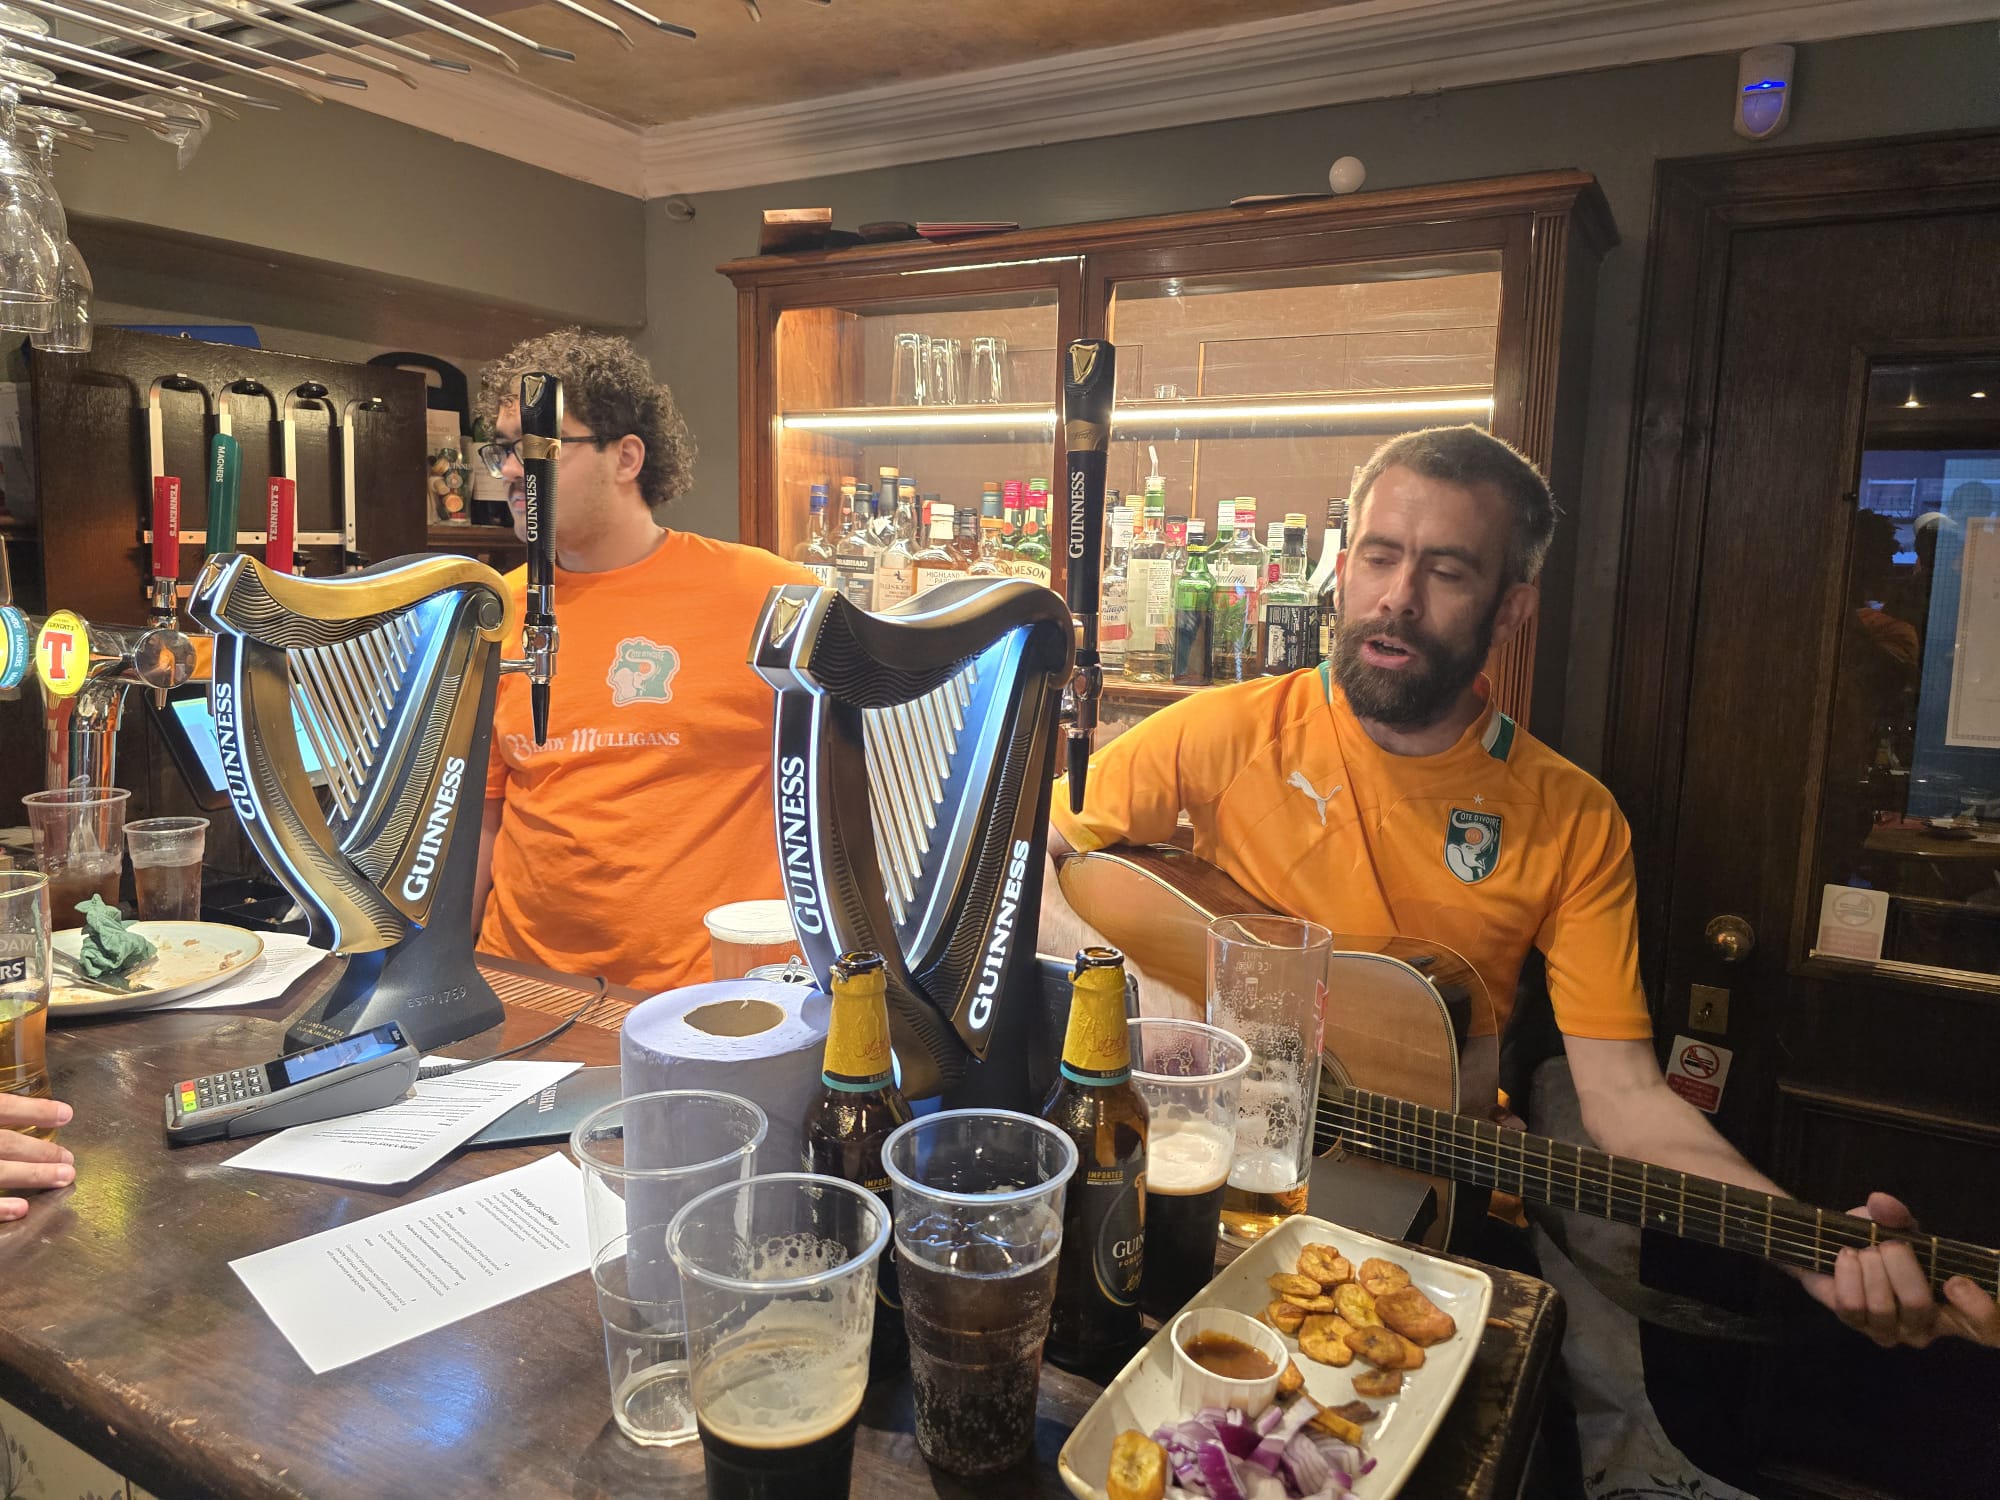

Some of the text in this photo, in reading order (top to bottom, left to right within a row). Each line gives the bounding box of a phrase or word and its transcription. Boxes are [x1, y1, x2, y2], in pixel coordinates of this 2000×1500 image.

[216, 446, 226, 483] MAGNERS
[527, 474, 539, 542] GUINNESS
[1069, 471, 1085, 559] GUINNESS
[1013, 565, 1047, 580] MESON
[43, 631, 73, 679] T
[216, 682, 256, 821] GUINNESS
[571, 728, 680, 753] MULLIGANS
[402, 756, 466, 901] GUINNESS
[780, 756, 823, 935] GUINNESS
[968, 839, 1030, 1030] GUINNESS
[864, 1176, 891, 1188] IMPORT
[1088, 1170, 1123, 1179] IMPORTED
[1112, 1233, 1145, 1259] GUIN
